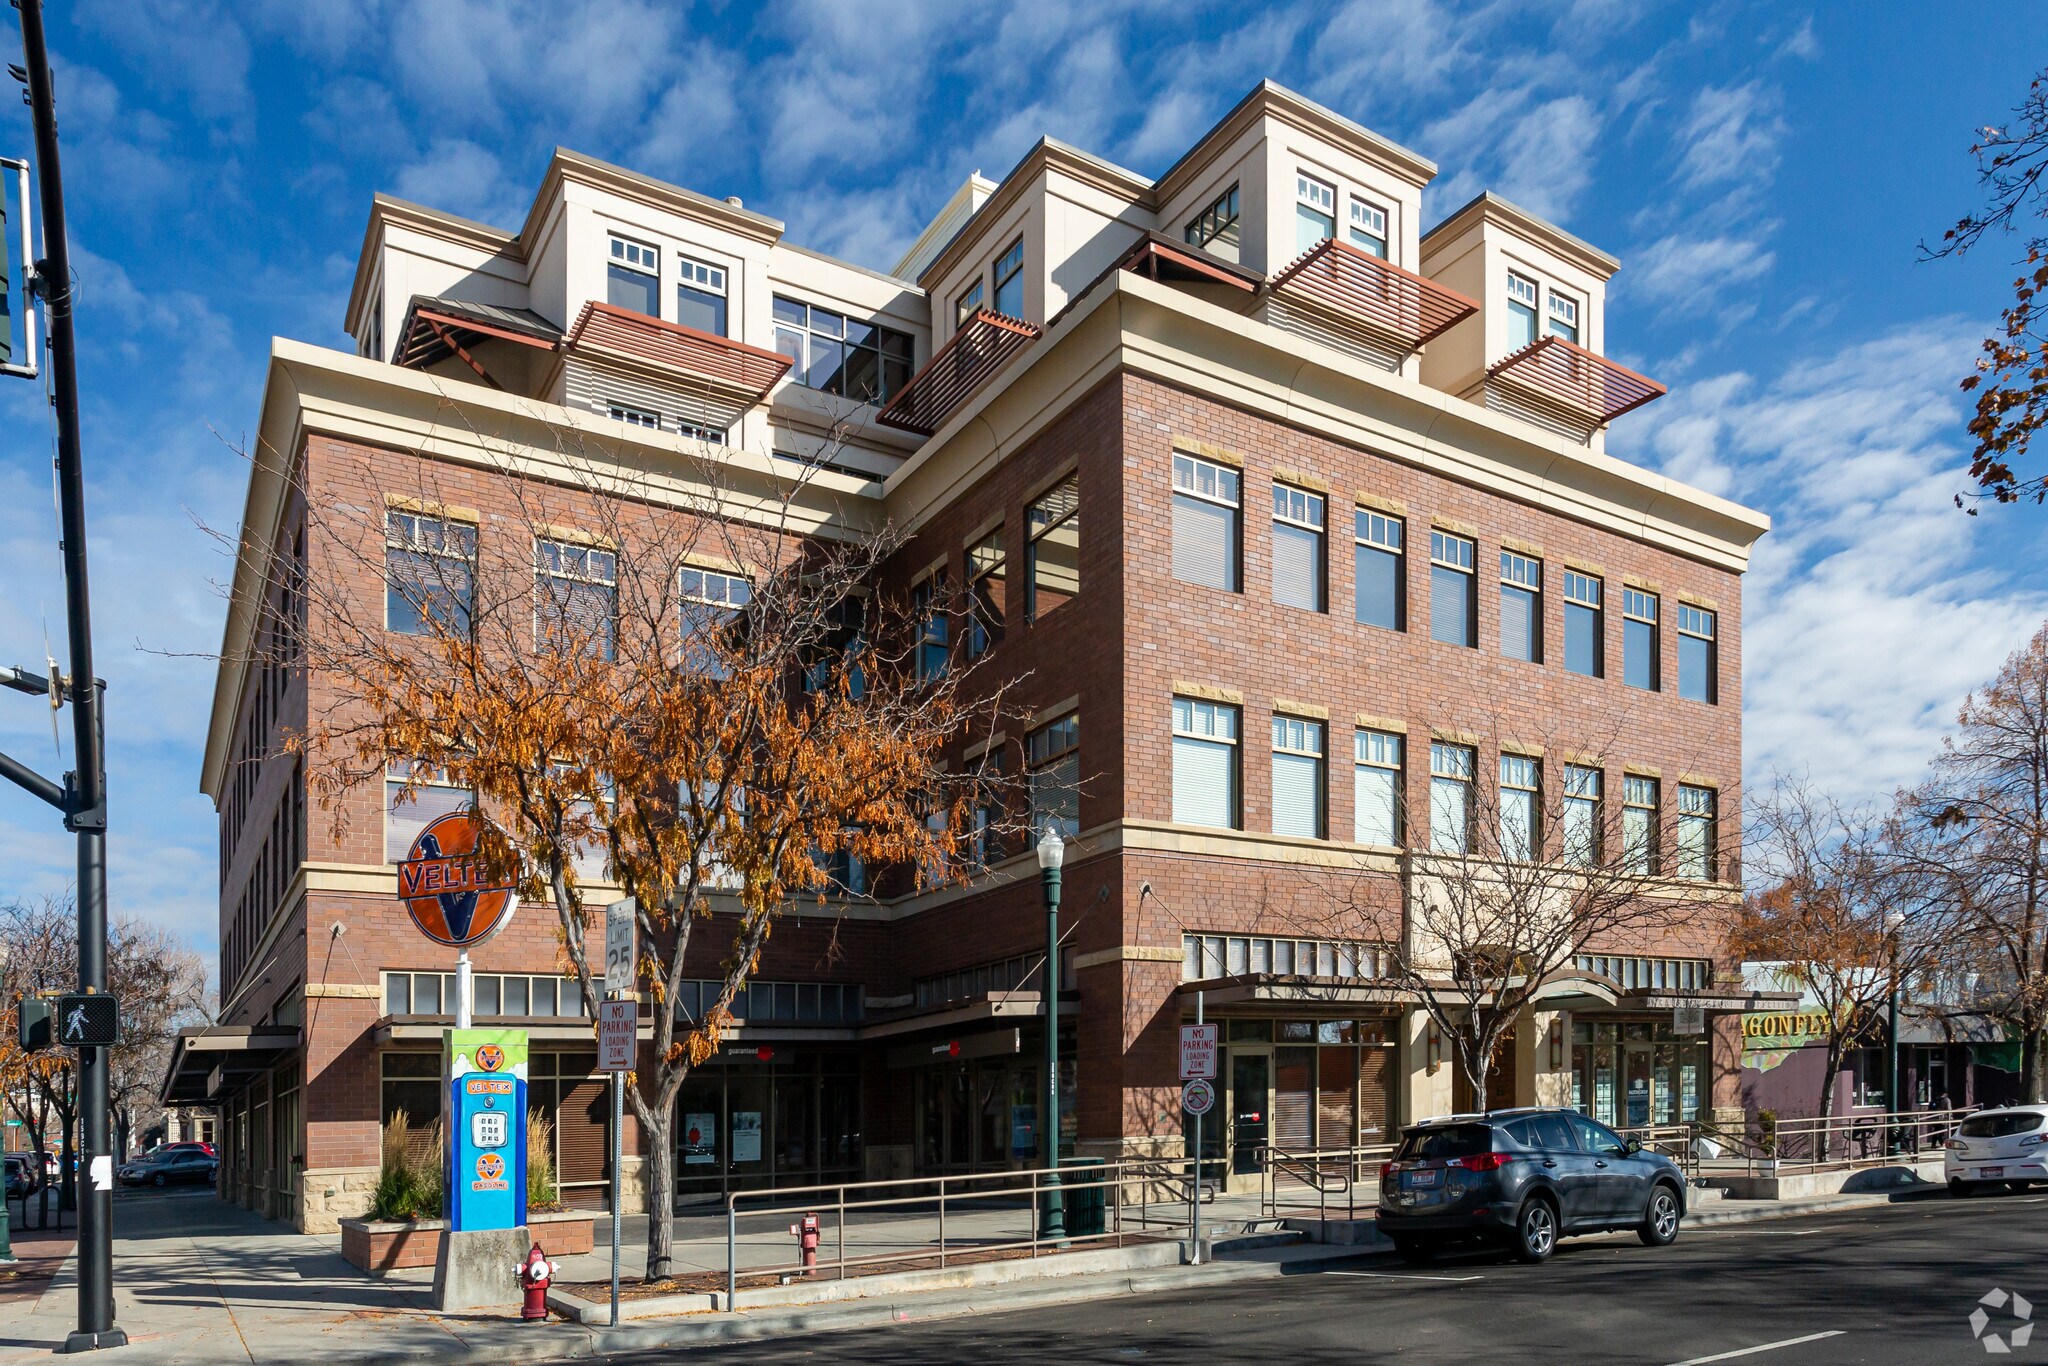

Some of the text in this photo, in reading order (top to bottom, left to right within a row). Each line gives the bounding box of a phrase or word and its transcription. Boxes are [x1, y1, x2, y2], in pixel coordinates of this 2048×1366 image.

[402, 861, 512, 894] VELTE
[609, 909, 631, 927] SPEED
[611, 928, 629, 944] LIMIT
[609, 946, 630, 980] 25
[612, 1006, 624, 1018] NO
[602, 1020, 633, 1033] PARKING
[1193, 1028, 1204, 1039] NO
[605, 1036, 630, 1046] LOADING
[1183, 1040, 1213, 1050] PARKING
[609, 1048, 624, 1057] ZONE
[1186, 1052, 1209, 1060] LOADING
[470, 1083, 510, 1091] VELTEX
